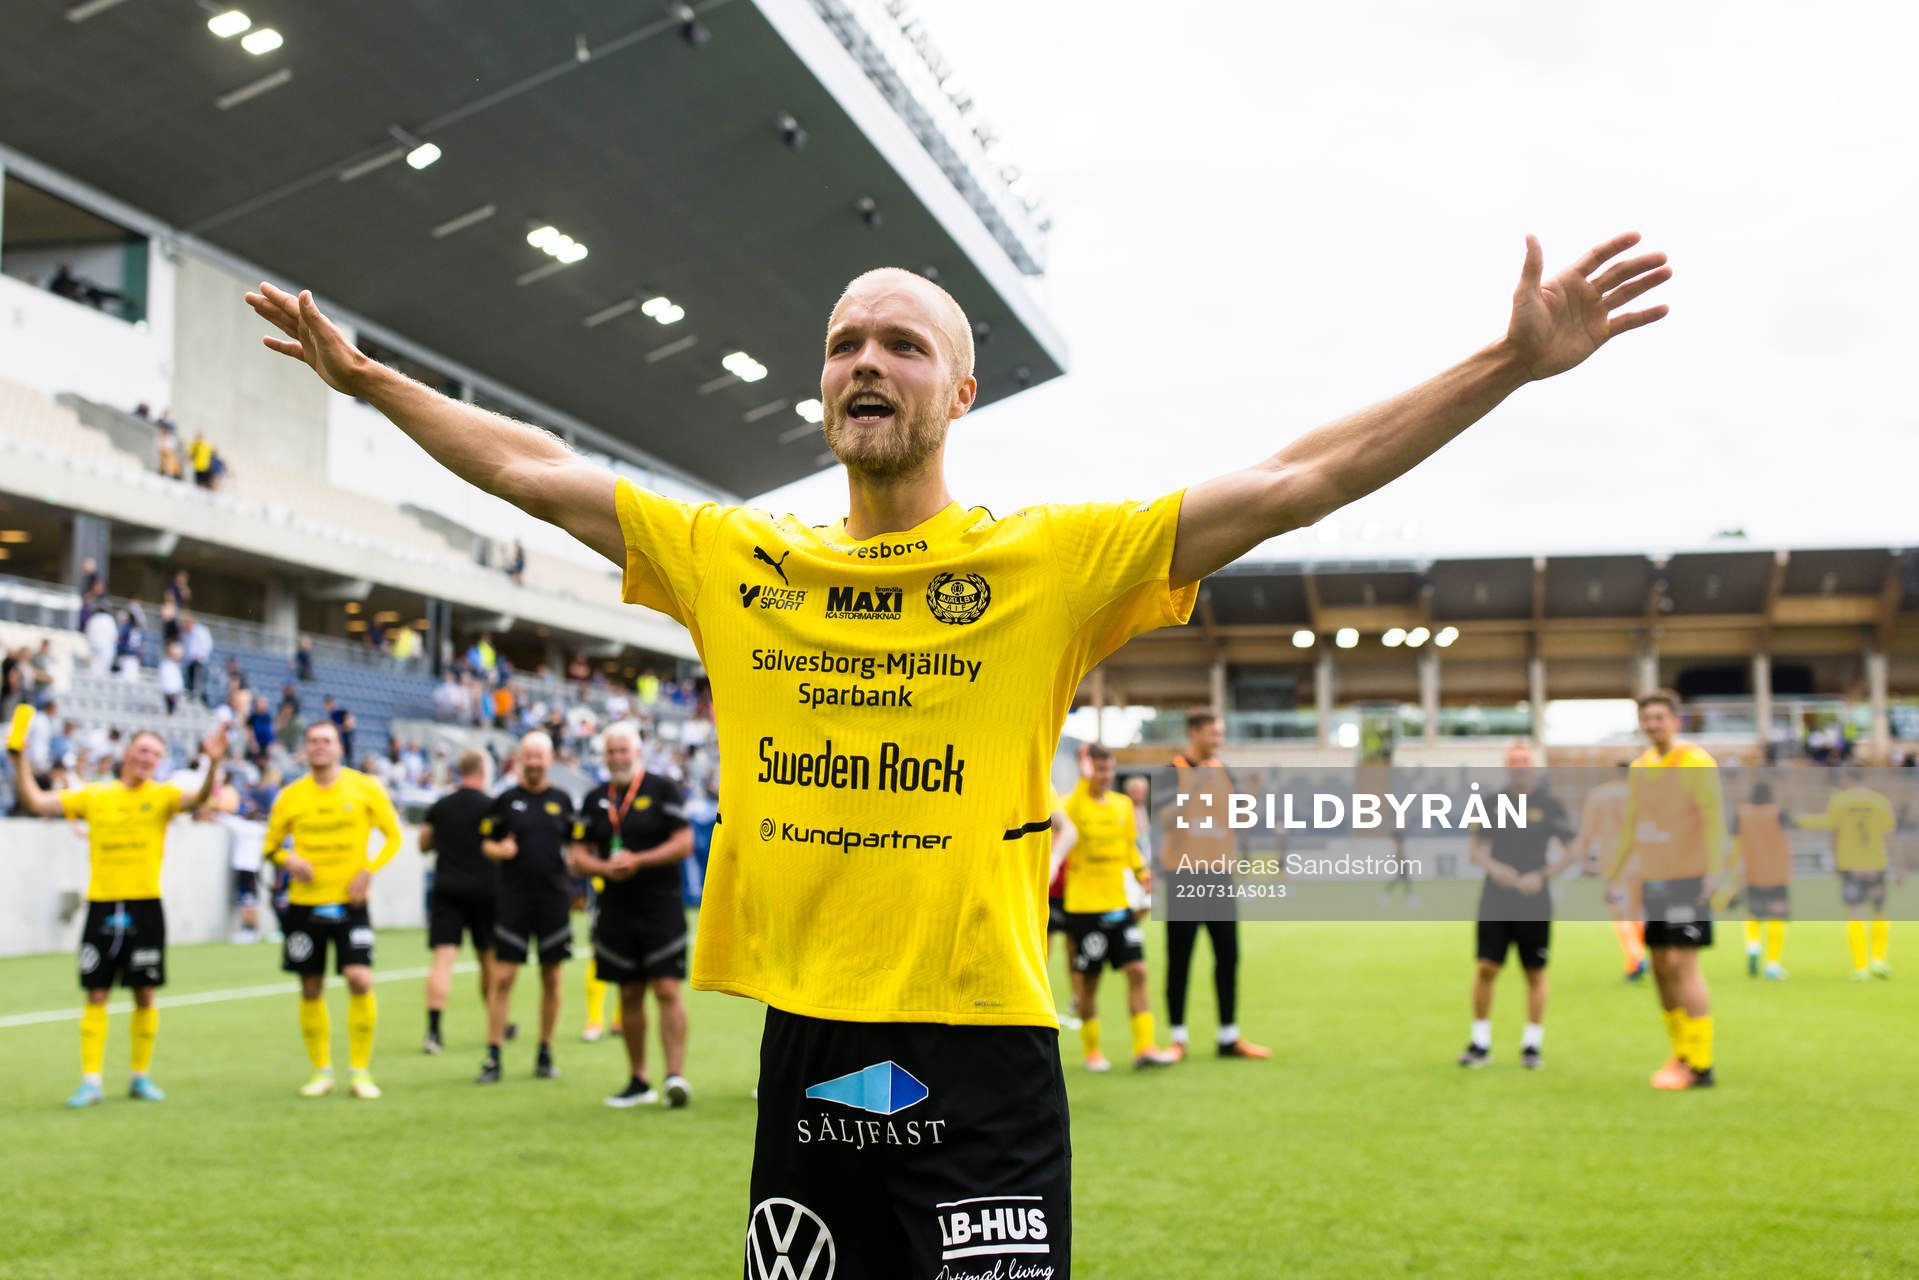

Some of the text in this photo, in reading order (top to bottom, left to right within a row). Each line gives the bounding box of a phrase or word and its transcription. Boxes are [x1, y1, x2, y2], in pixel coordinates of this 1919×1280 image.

[760, 597, 804, 611] SPORT
[762, 585, 806, 602] INTER
[827, 586, 903, 613] MAXI
[825, 611, 902, 621] ICA STORMARKNAD
[752, 649, 983, 682] Sölvesborg-Mjällby
[798, 682, 913, 709] Sparbank
[758, 736, 965, 796] Sweden Rock
[782, 822, 953, 854] Kundpartner
[797, 1113, 946, 1150] SÄLJFAST
[938, 1207, 1049, 1247] LB-HUS
[1008, 1258, 1055, 1280] living
